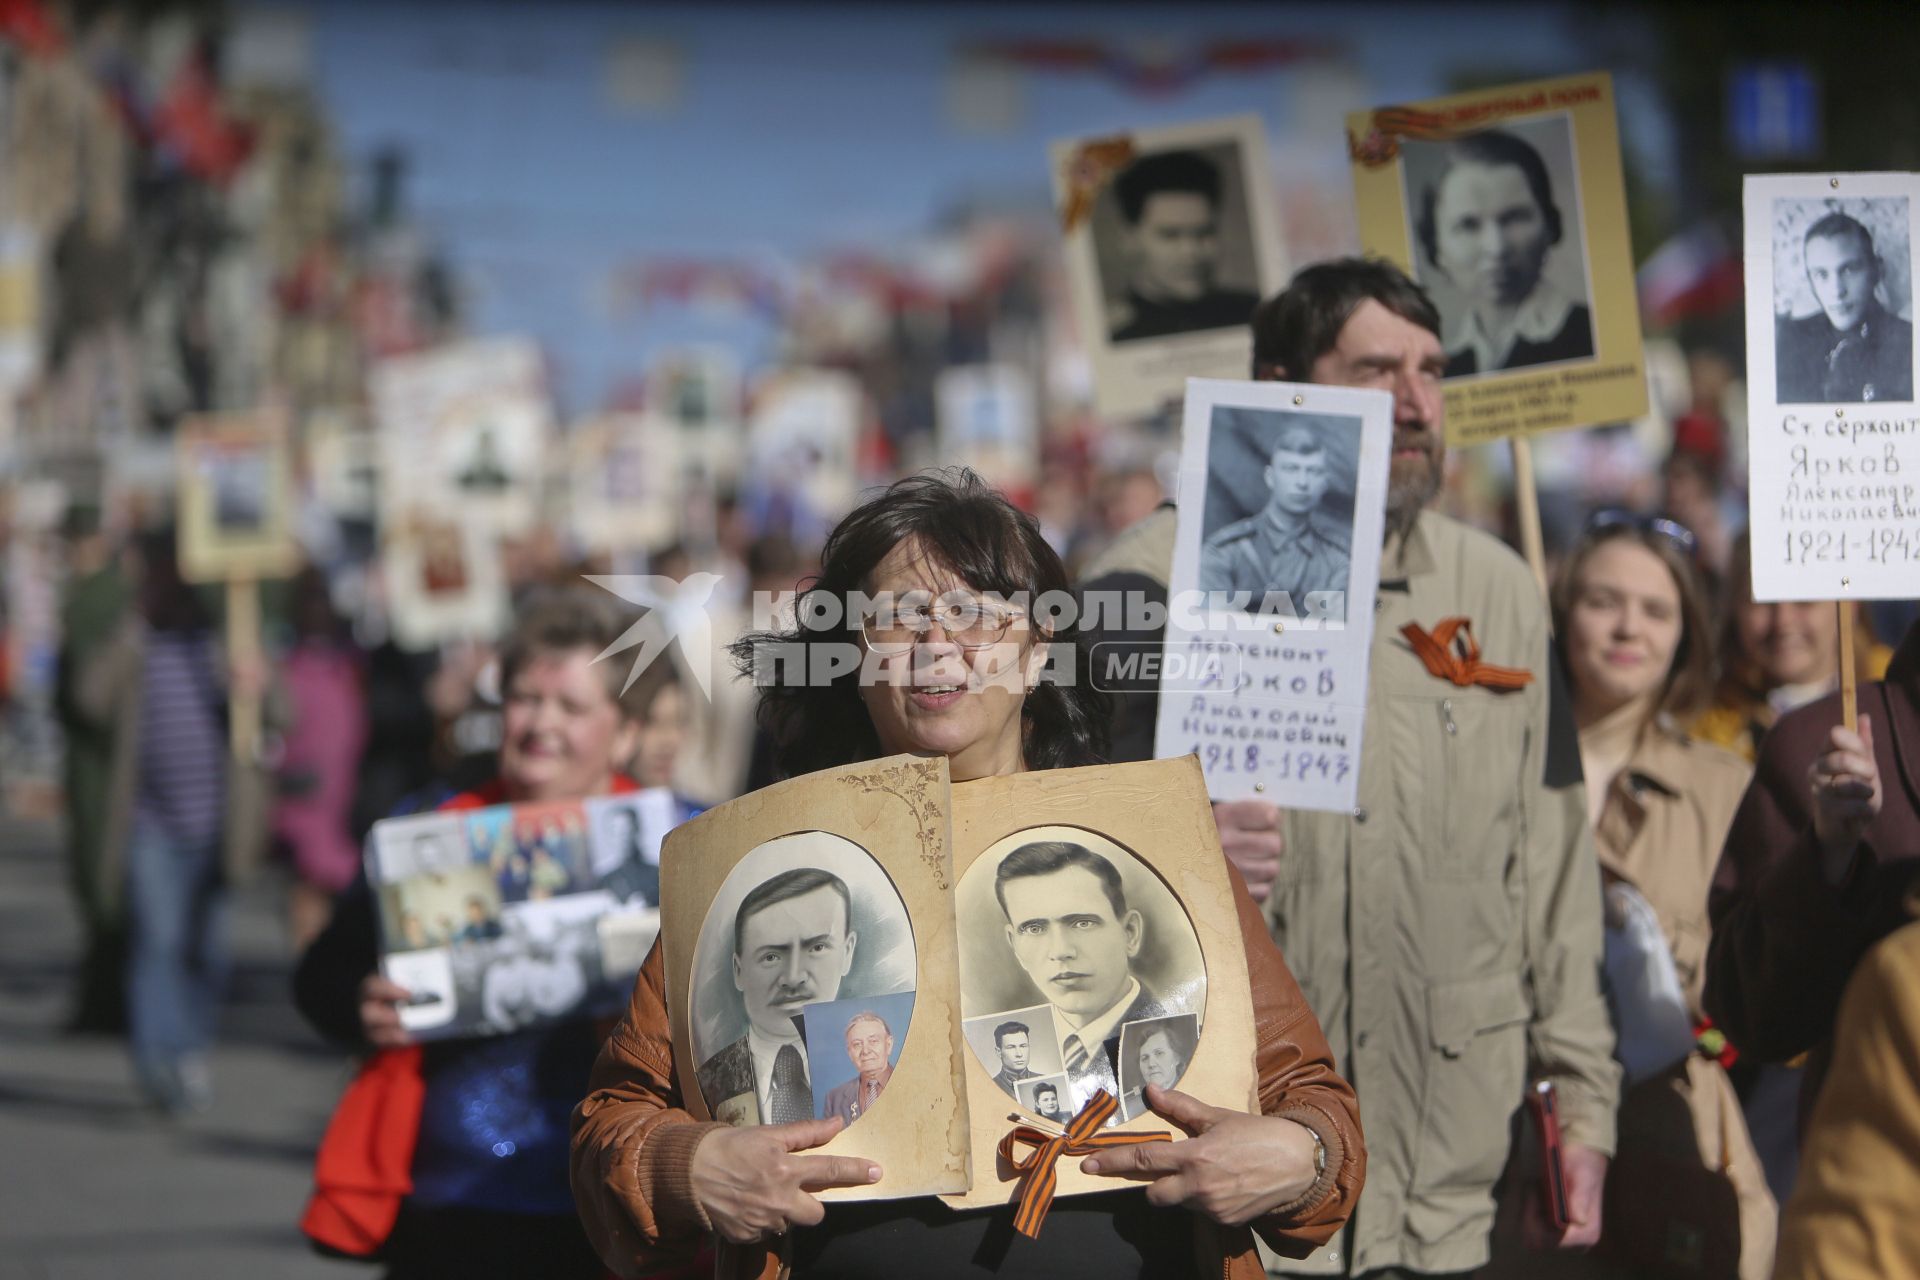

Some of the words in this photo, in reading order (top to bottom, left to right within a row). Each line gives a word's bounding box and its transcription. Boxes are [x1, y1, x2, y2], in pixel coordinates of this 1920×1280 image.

[1824, 417, 1920, 446] сержант
[1790, 441, 1900, 485] Ярков
[1786, 482, 1914, 503] Александр
[1780, 502, 1920, 522] Николаеви
[1188, 634, 1328, 662] Лейтенант
[1201, 661, 1334, 697] Ярков
[1191, 696, 1336, 726] Анатолий
[1182, 717, 1347, 747] Николаевич
